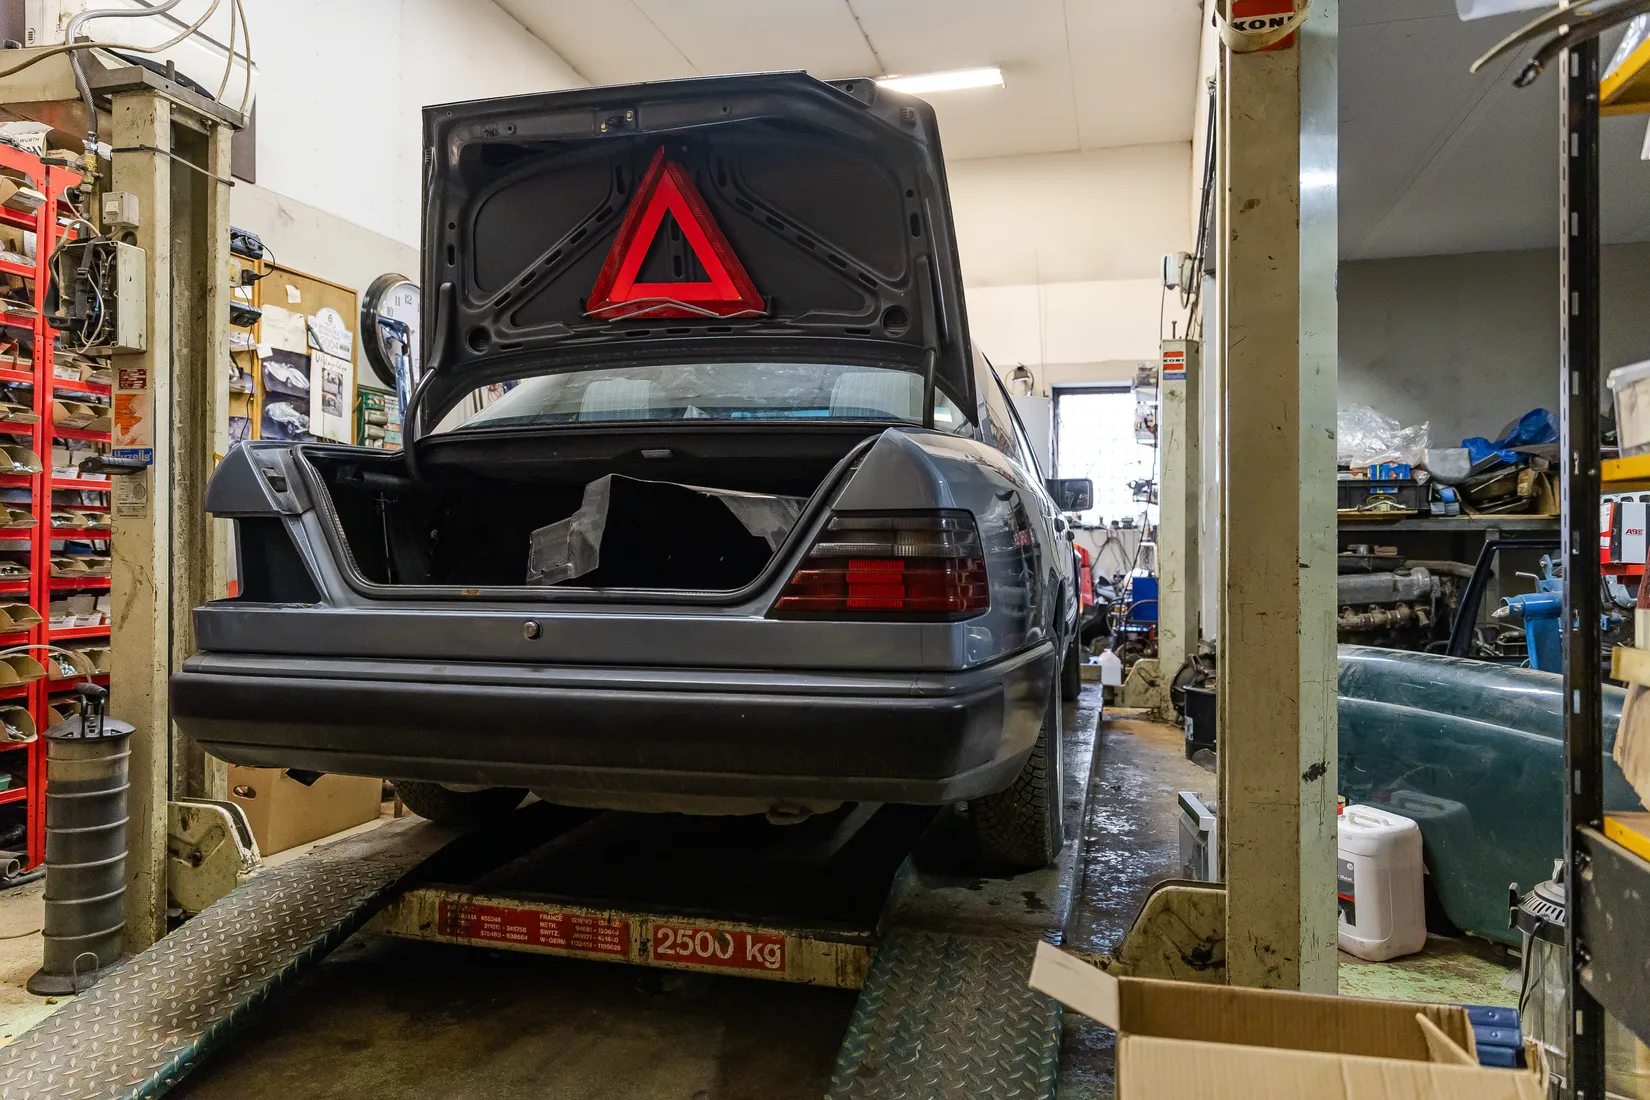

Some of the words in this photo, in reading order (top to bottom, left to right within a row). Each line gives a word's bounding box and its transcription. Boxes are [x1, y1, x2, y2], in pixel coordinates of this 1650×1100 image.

[1231, 16, 1294, 31] KON
[395, 296, 400, 306] 11
[405, 294, 412, 305] 12
[387, 307, 393, 317] 10
[328, 314, 333, 323] 6
[540, 914, 562, 922] FRANCE
[540, 929, 560, 937] SWITZ.
[657, 927, 734, 959] 2500
[746, 934, 781, 969] kg
